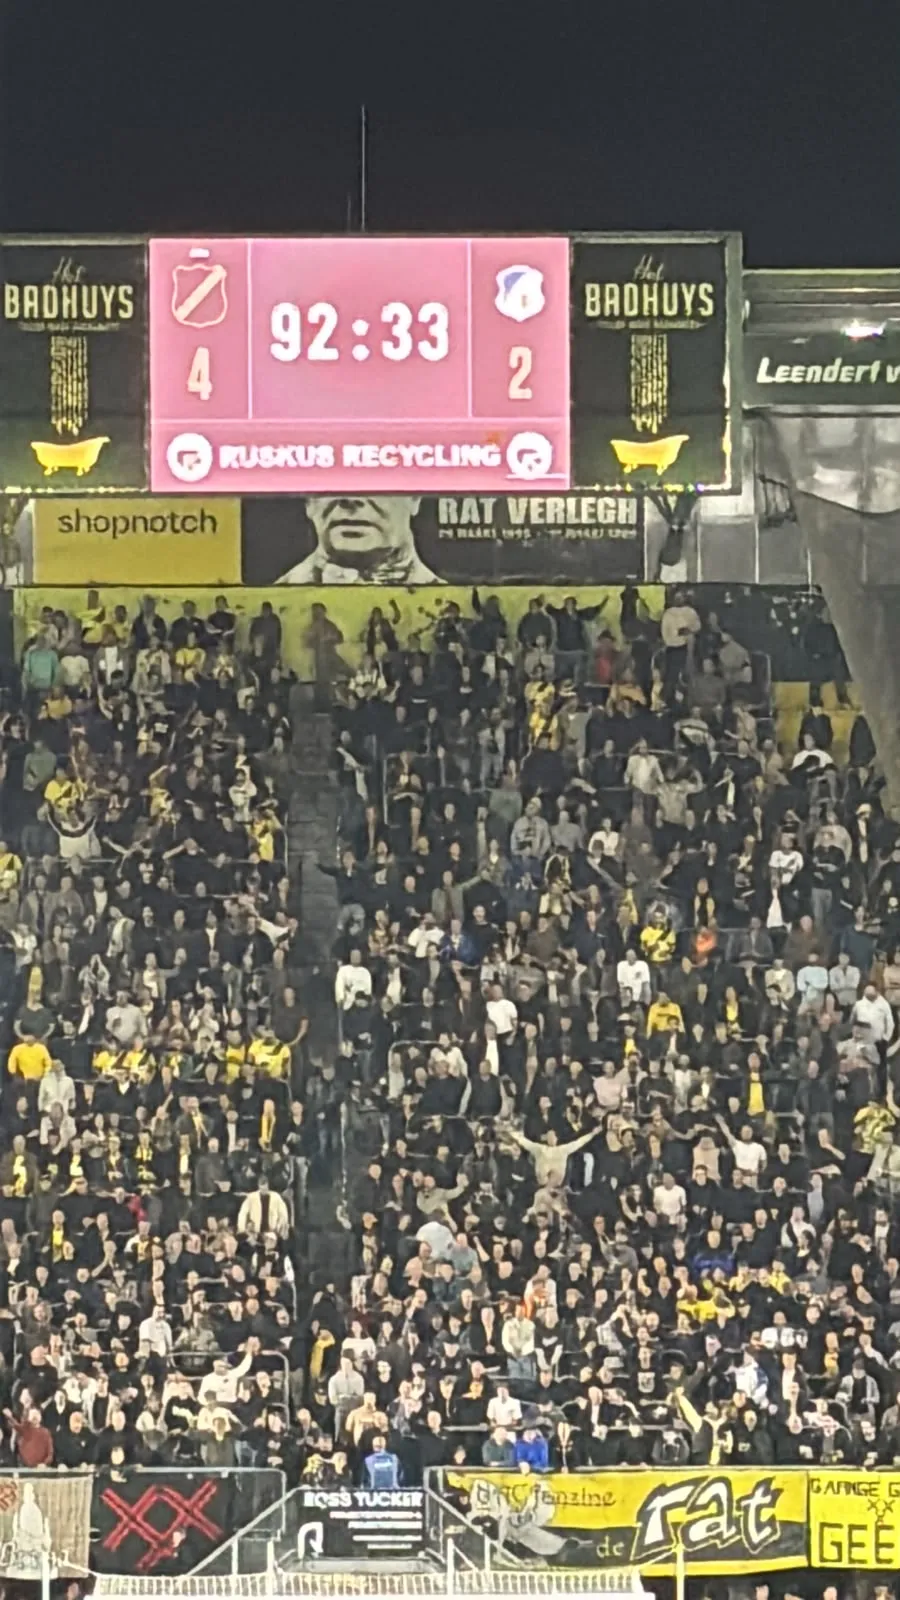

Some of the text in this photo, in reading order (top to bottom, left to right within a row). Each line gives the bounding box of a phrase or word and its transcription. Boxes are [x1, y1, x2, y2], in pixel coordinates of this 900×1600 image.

[4, 283, 134, 319] BADHUYS
[584, 282, 714, 318] BADHUYS
[270, 301, 449, 362] 92:33
[187, 346, 213, 401] 4
[508, 346, 533, 400] 2
[756, 356, 881, 384] Leendert
[342, 444, 501, 468] RECYCLING
[58, 507, 218, 540] shopnotch
[438, 497, 637, 525] RAT VERLEGH
[596, 1476, 783, 1558] de rat
